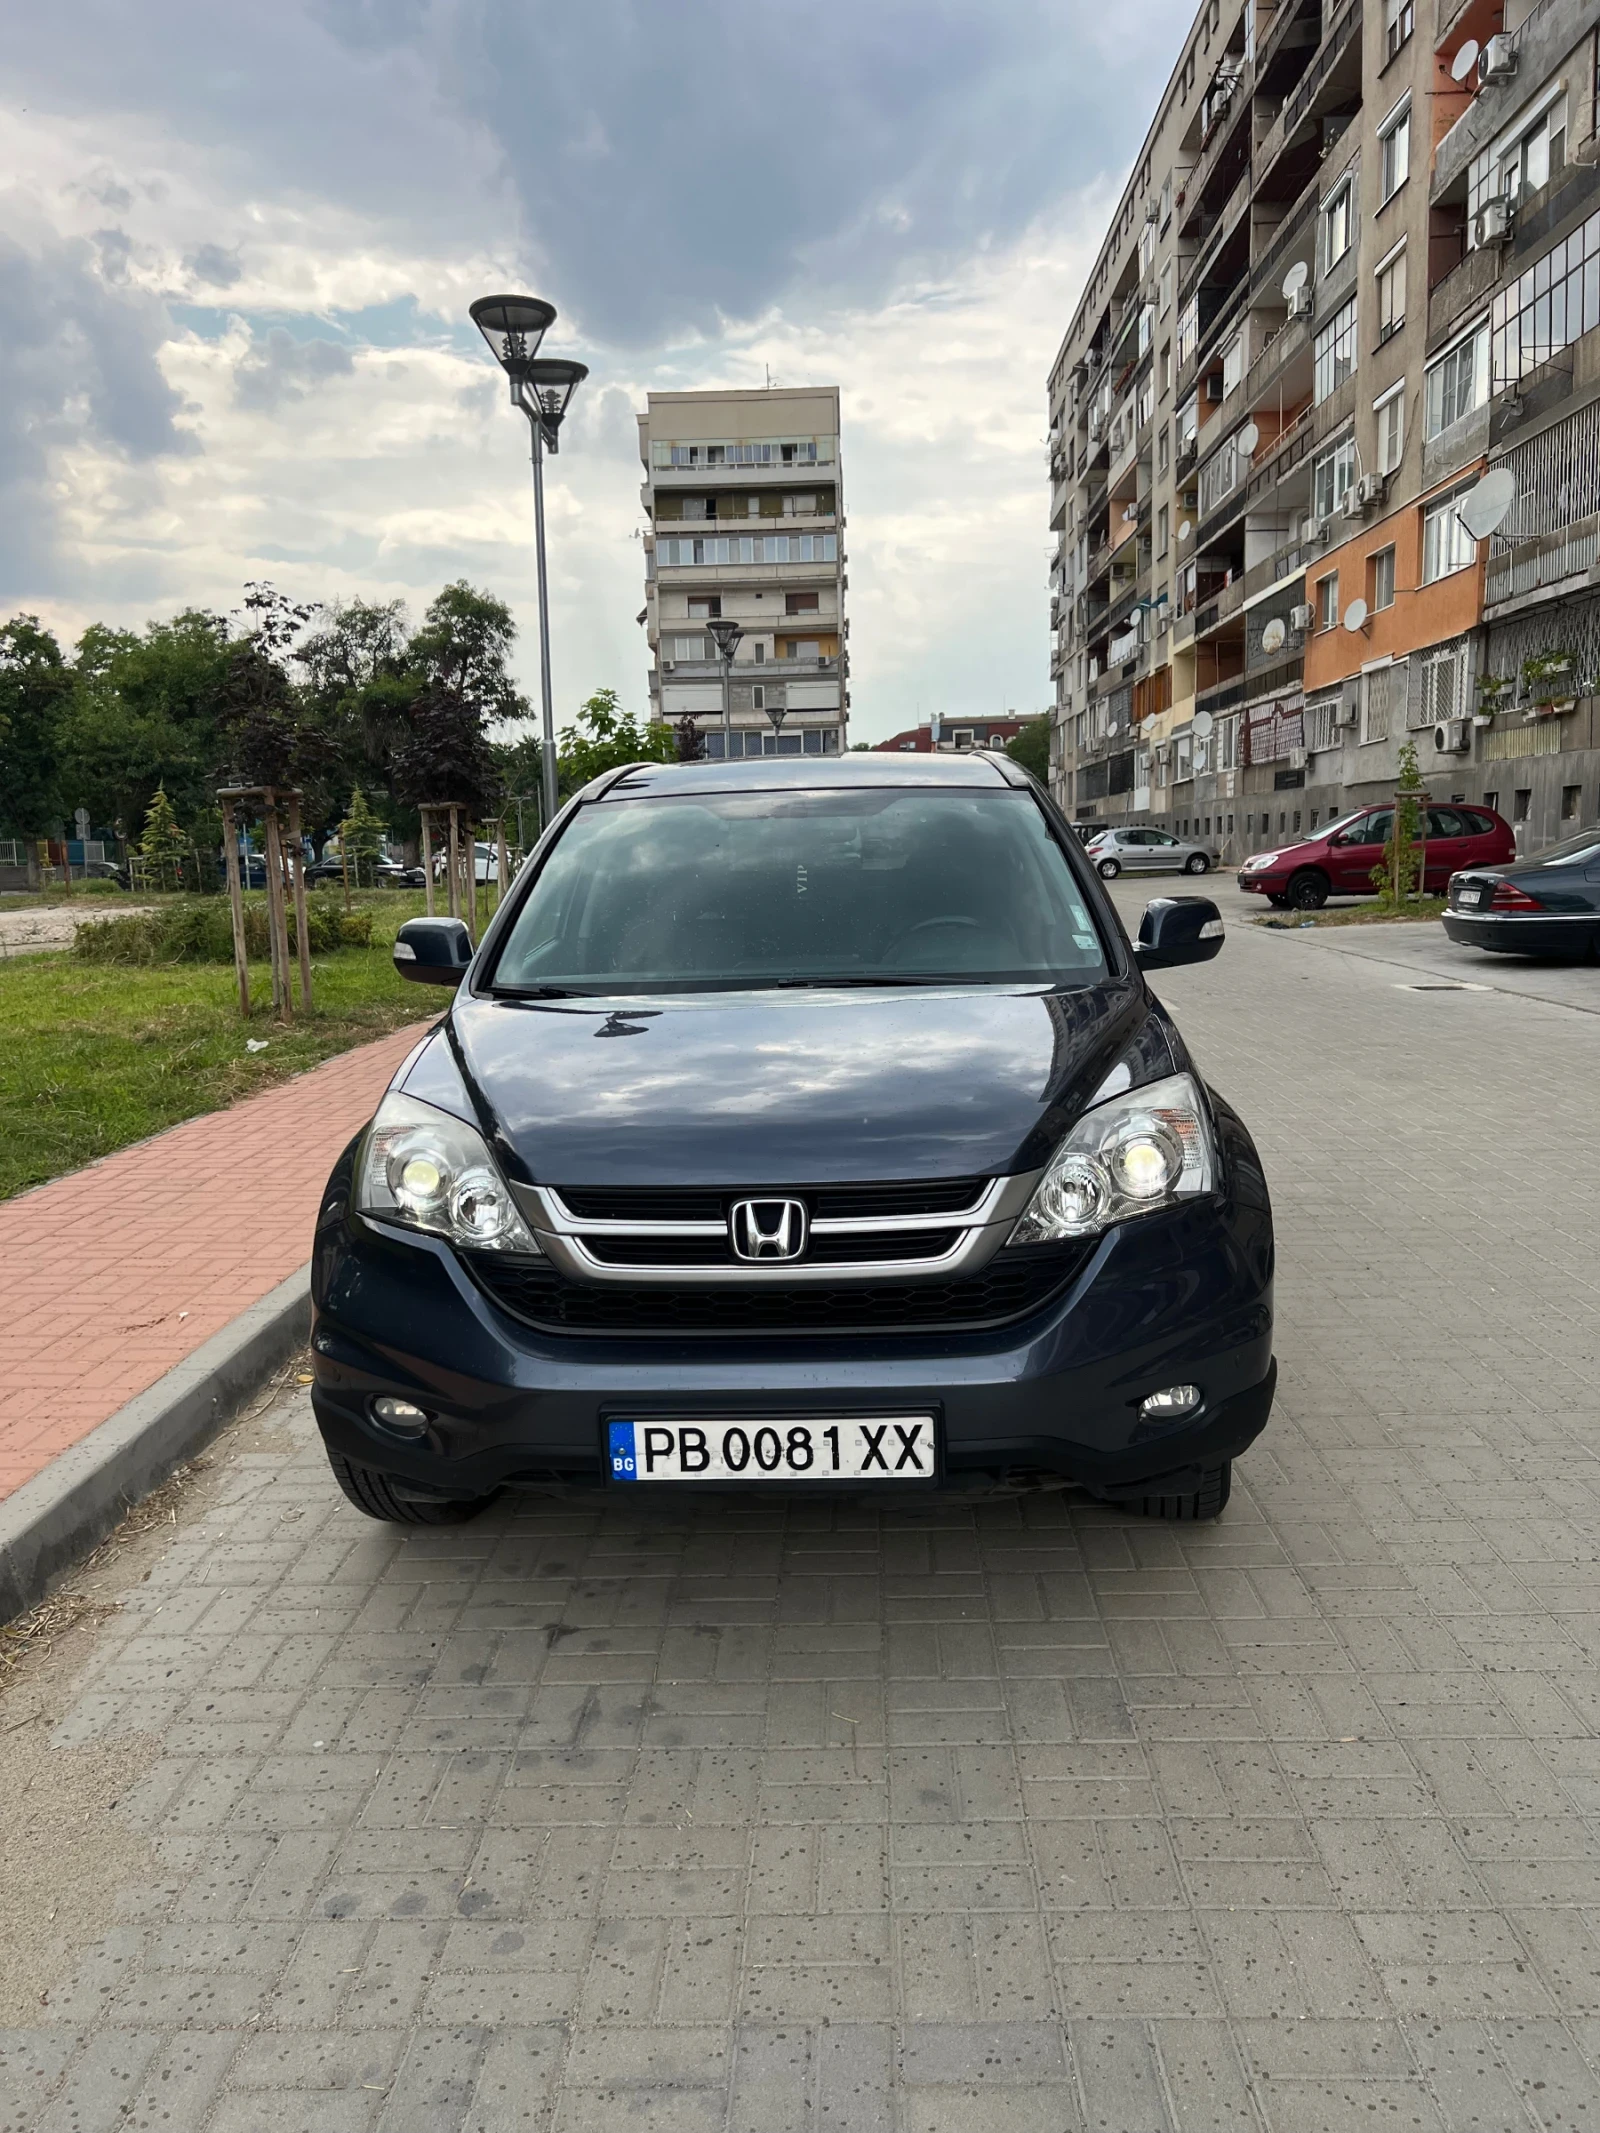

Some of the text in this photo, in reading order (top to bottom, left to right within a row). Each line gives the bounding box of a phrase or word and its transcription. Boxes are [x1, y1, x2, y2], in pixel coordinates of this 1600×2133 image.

[797, 865, 808, 893] VIP
[643, 1424, 924, 1473] PB 0081 XX
[613, 1457, 634, 1472] BG
